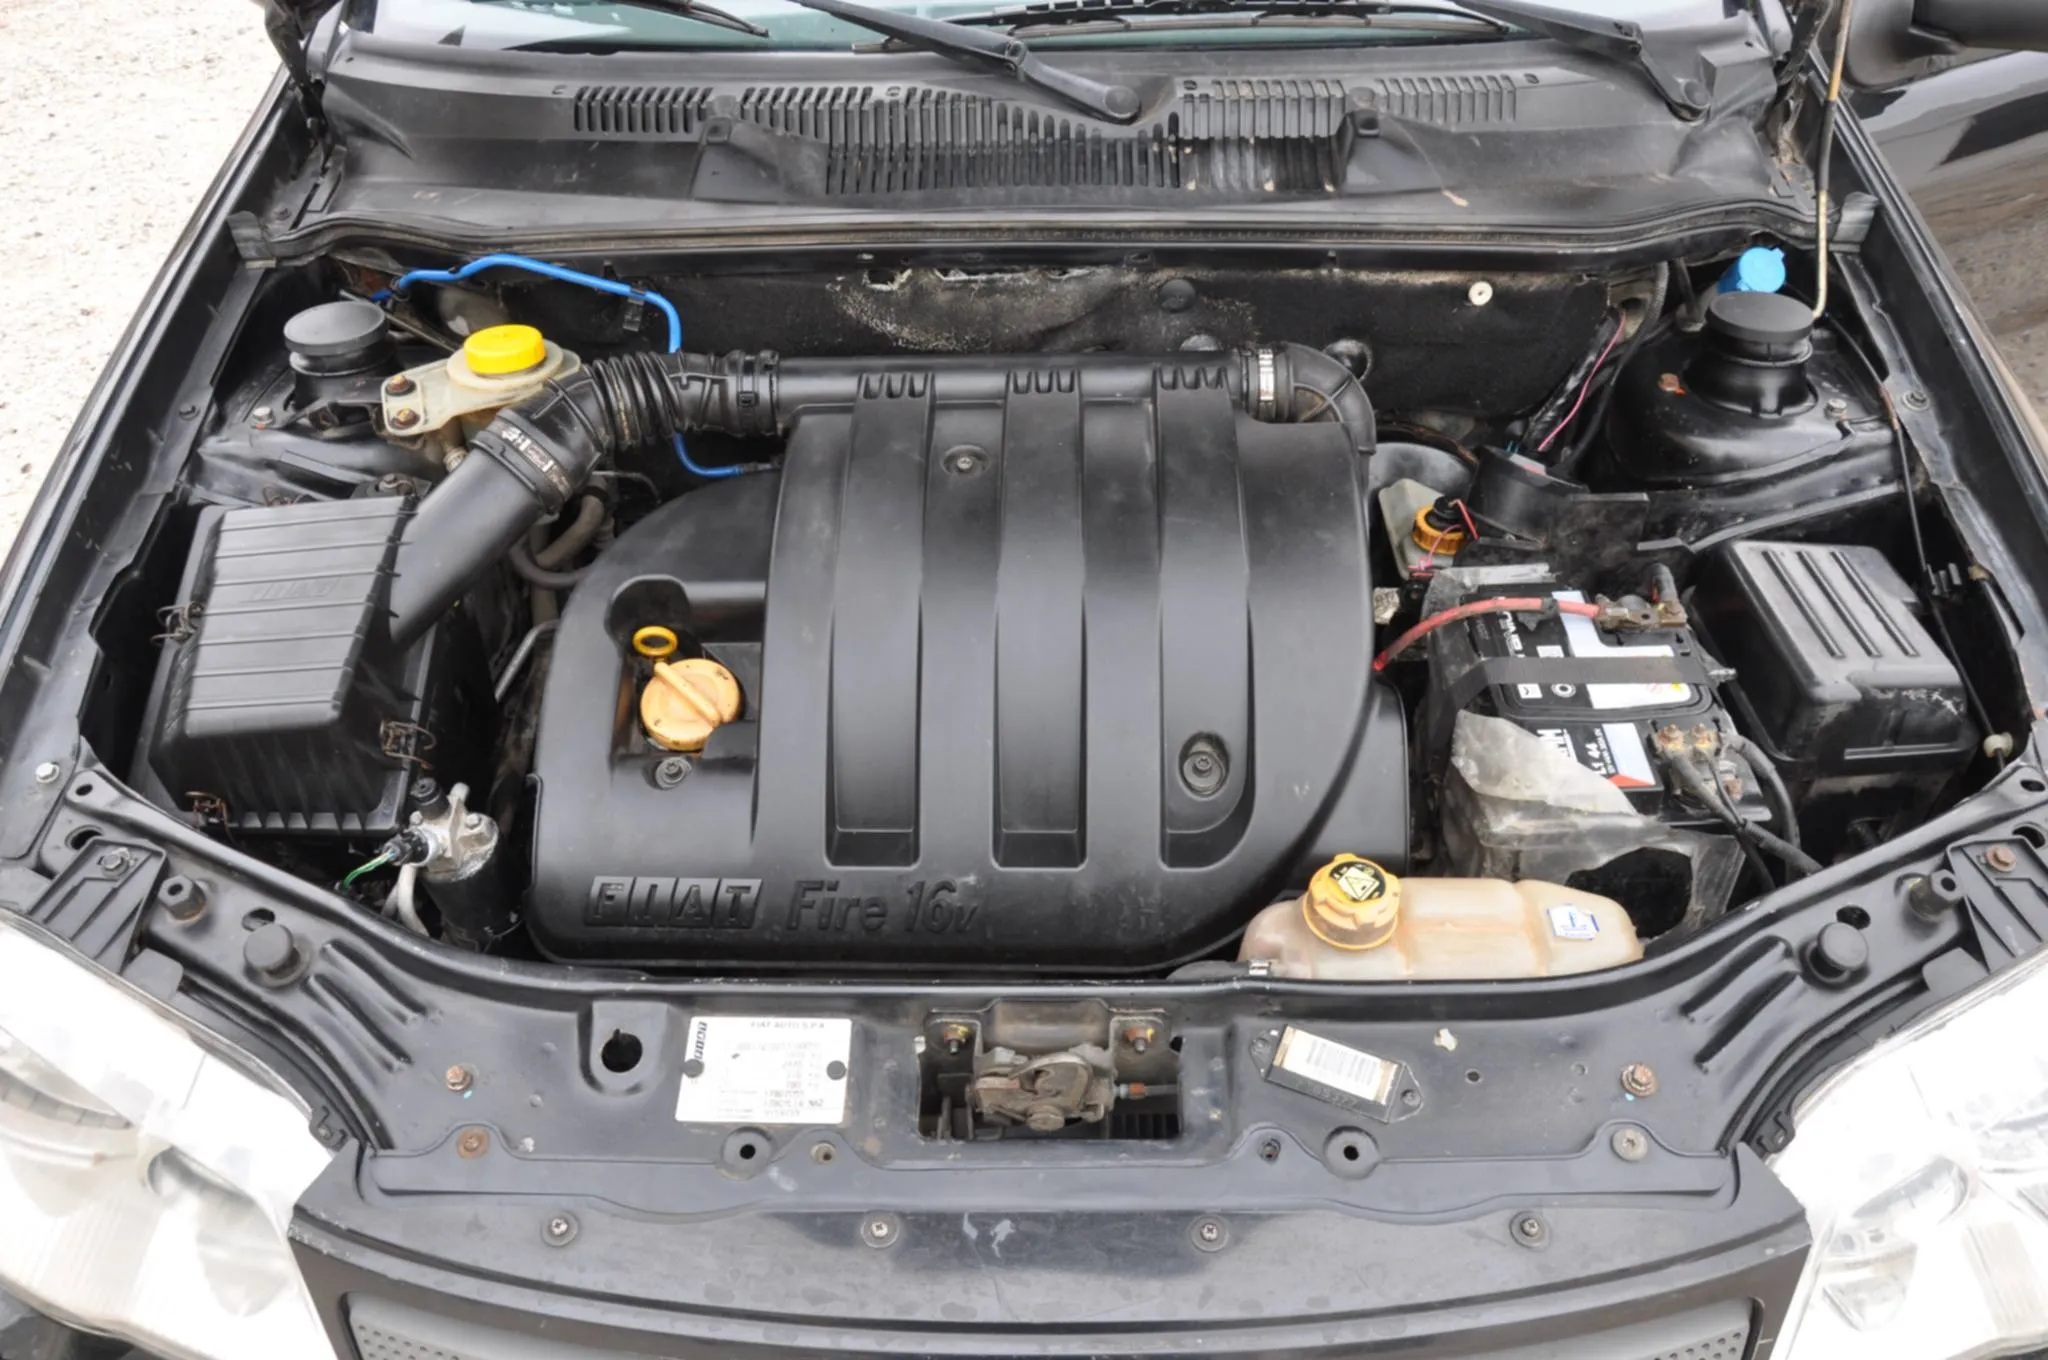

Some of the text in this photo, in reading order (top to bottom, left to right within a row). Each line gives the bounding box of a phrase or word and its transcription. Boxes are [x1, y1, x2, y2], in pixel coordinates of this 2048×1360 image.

[586, 877, 979, 934] FIAT Fire 16v
